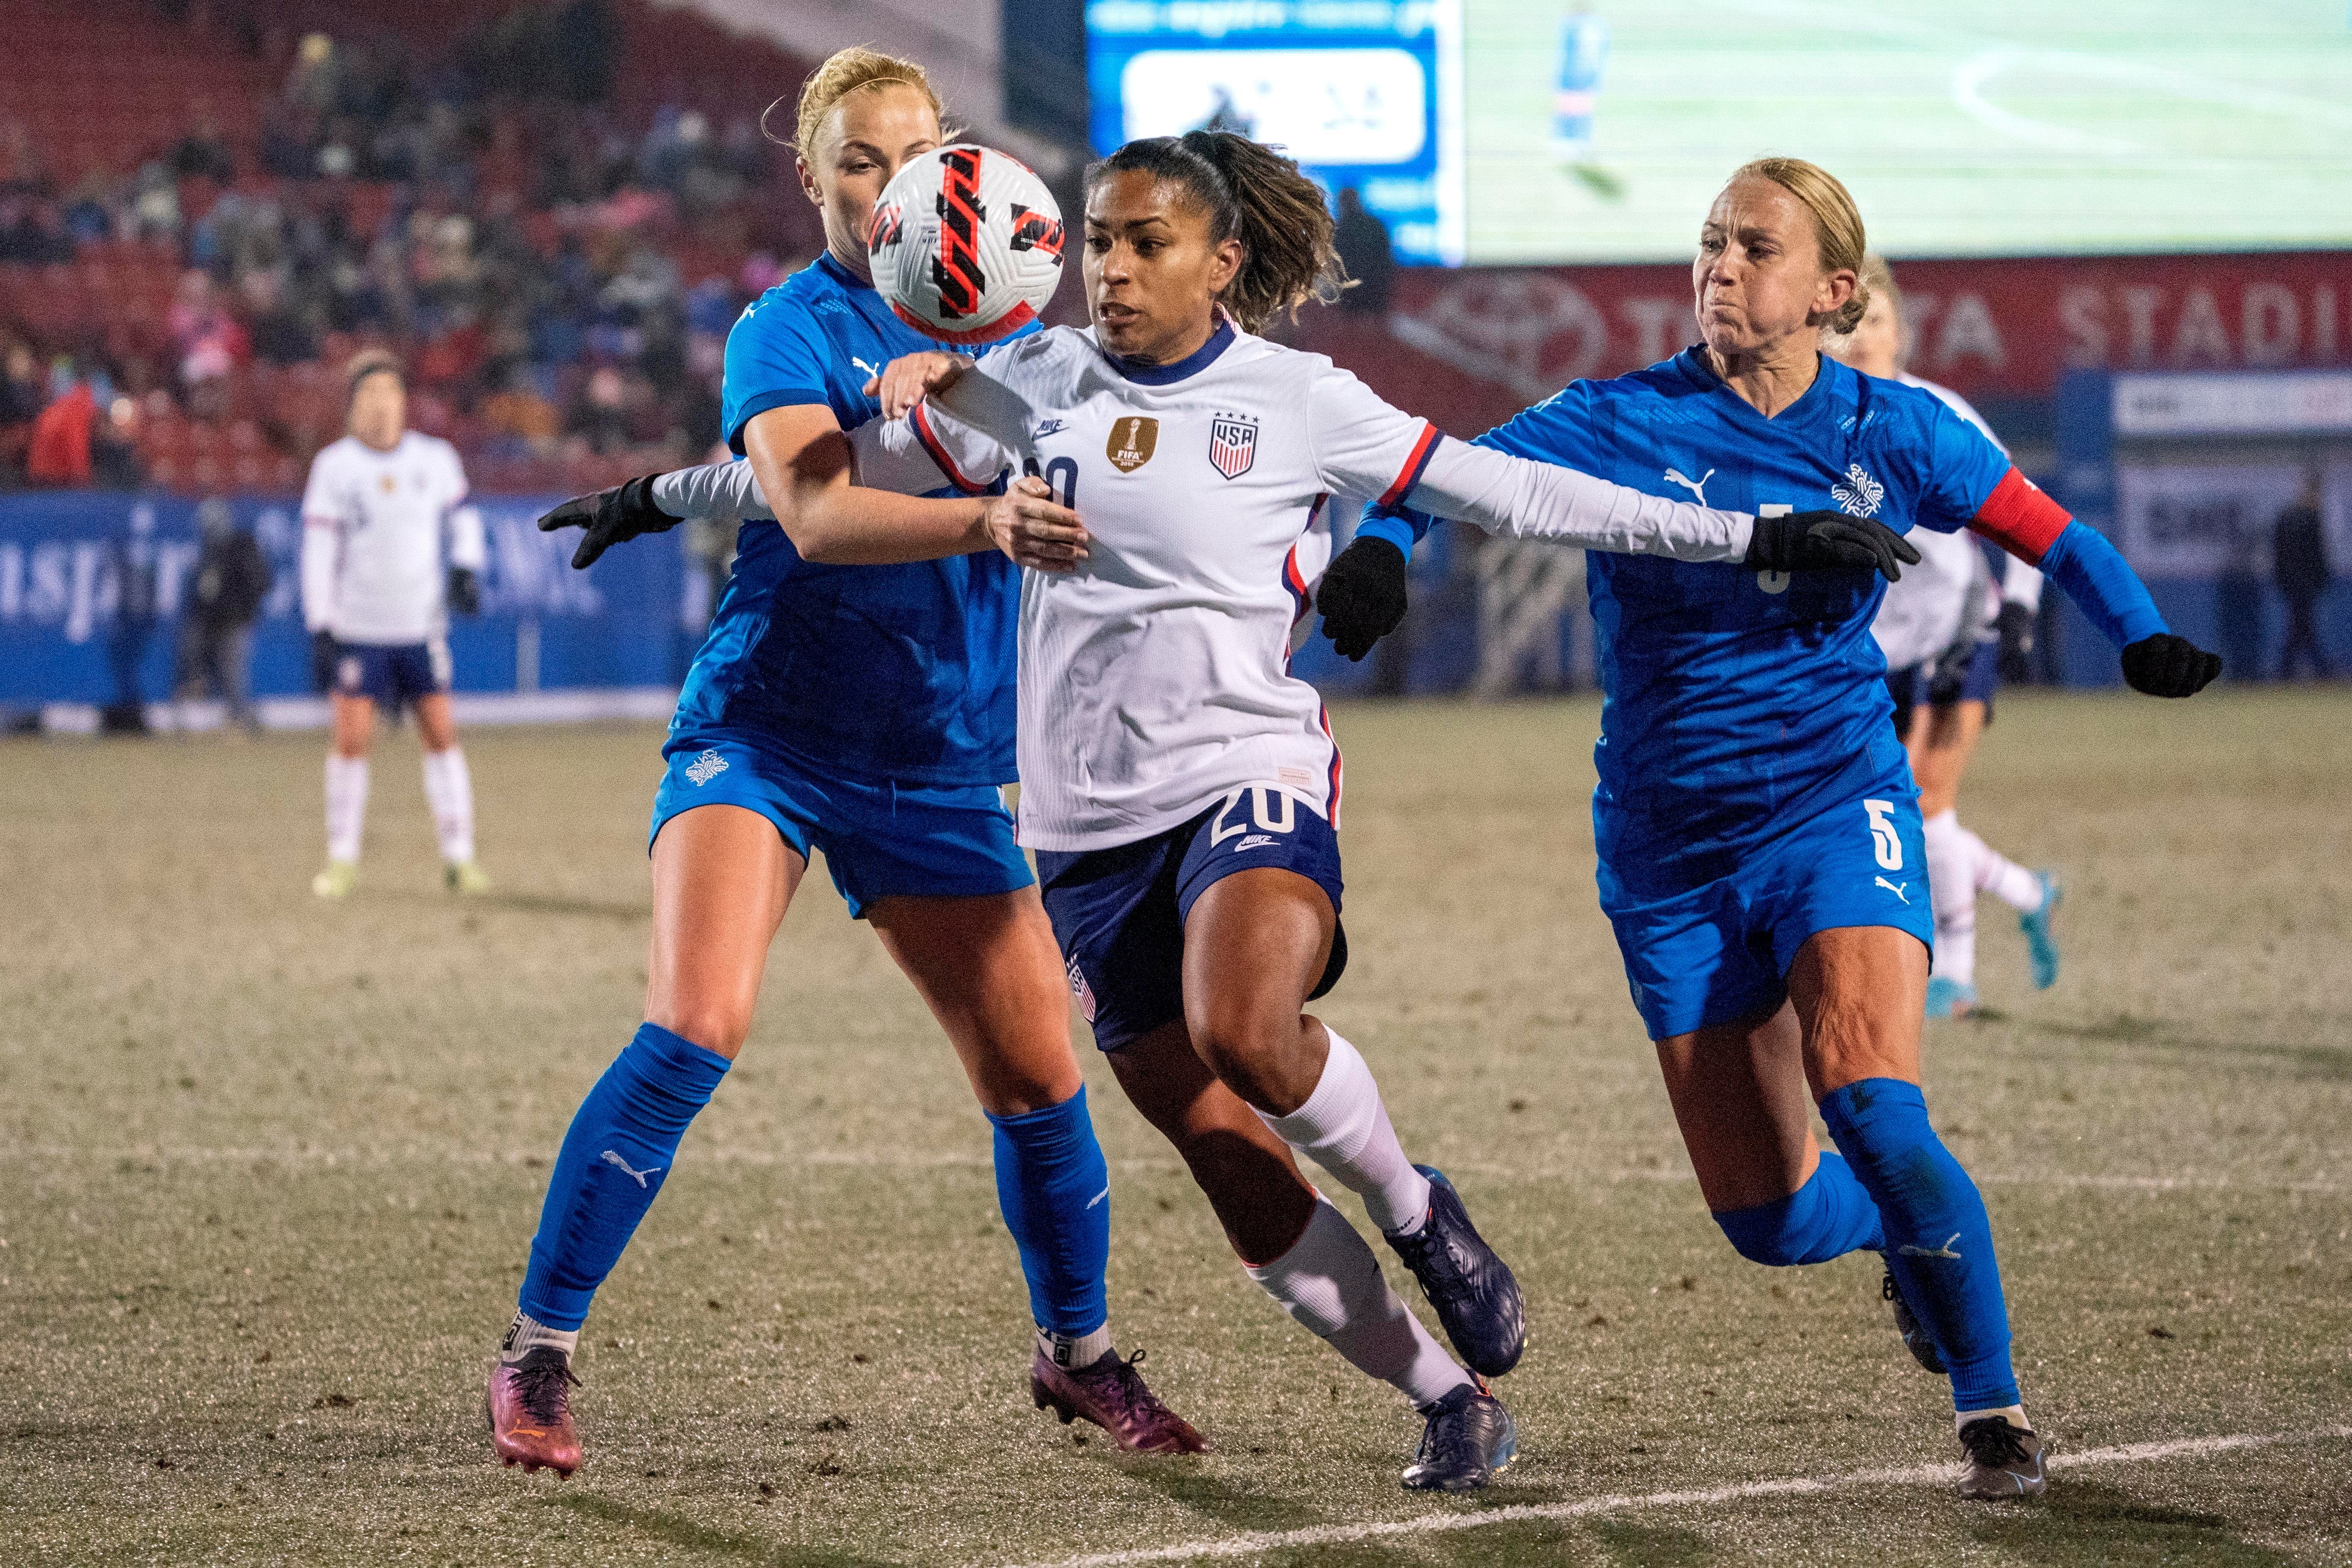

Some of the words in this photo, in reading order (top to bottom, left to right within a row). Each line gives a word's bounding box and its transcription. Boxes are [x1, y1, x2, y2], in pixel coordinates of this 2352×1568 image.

[1217, 424, 1253, 446] USA
[1118, 450, 1139, 460] FIFA
[1211, 787, 1295, 848] 20
[1242, 835, 1272, 844] NIKE
[1863, 799, 1903, 870] 5
